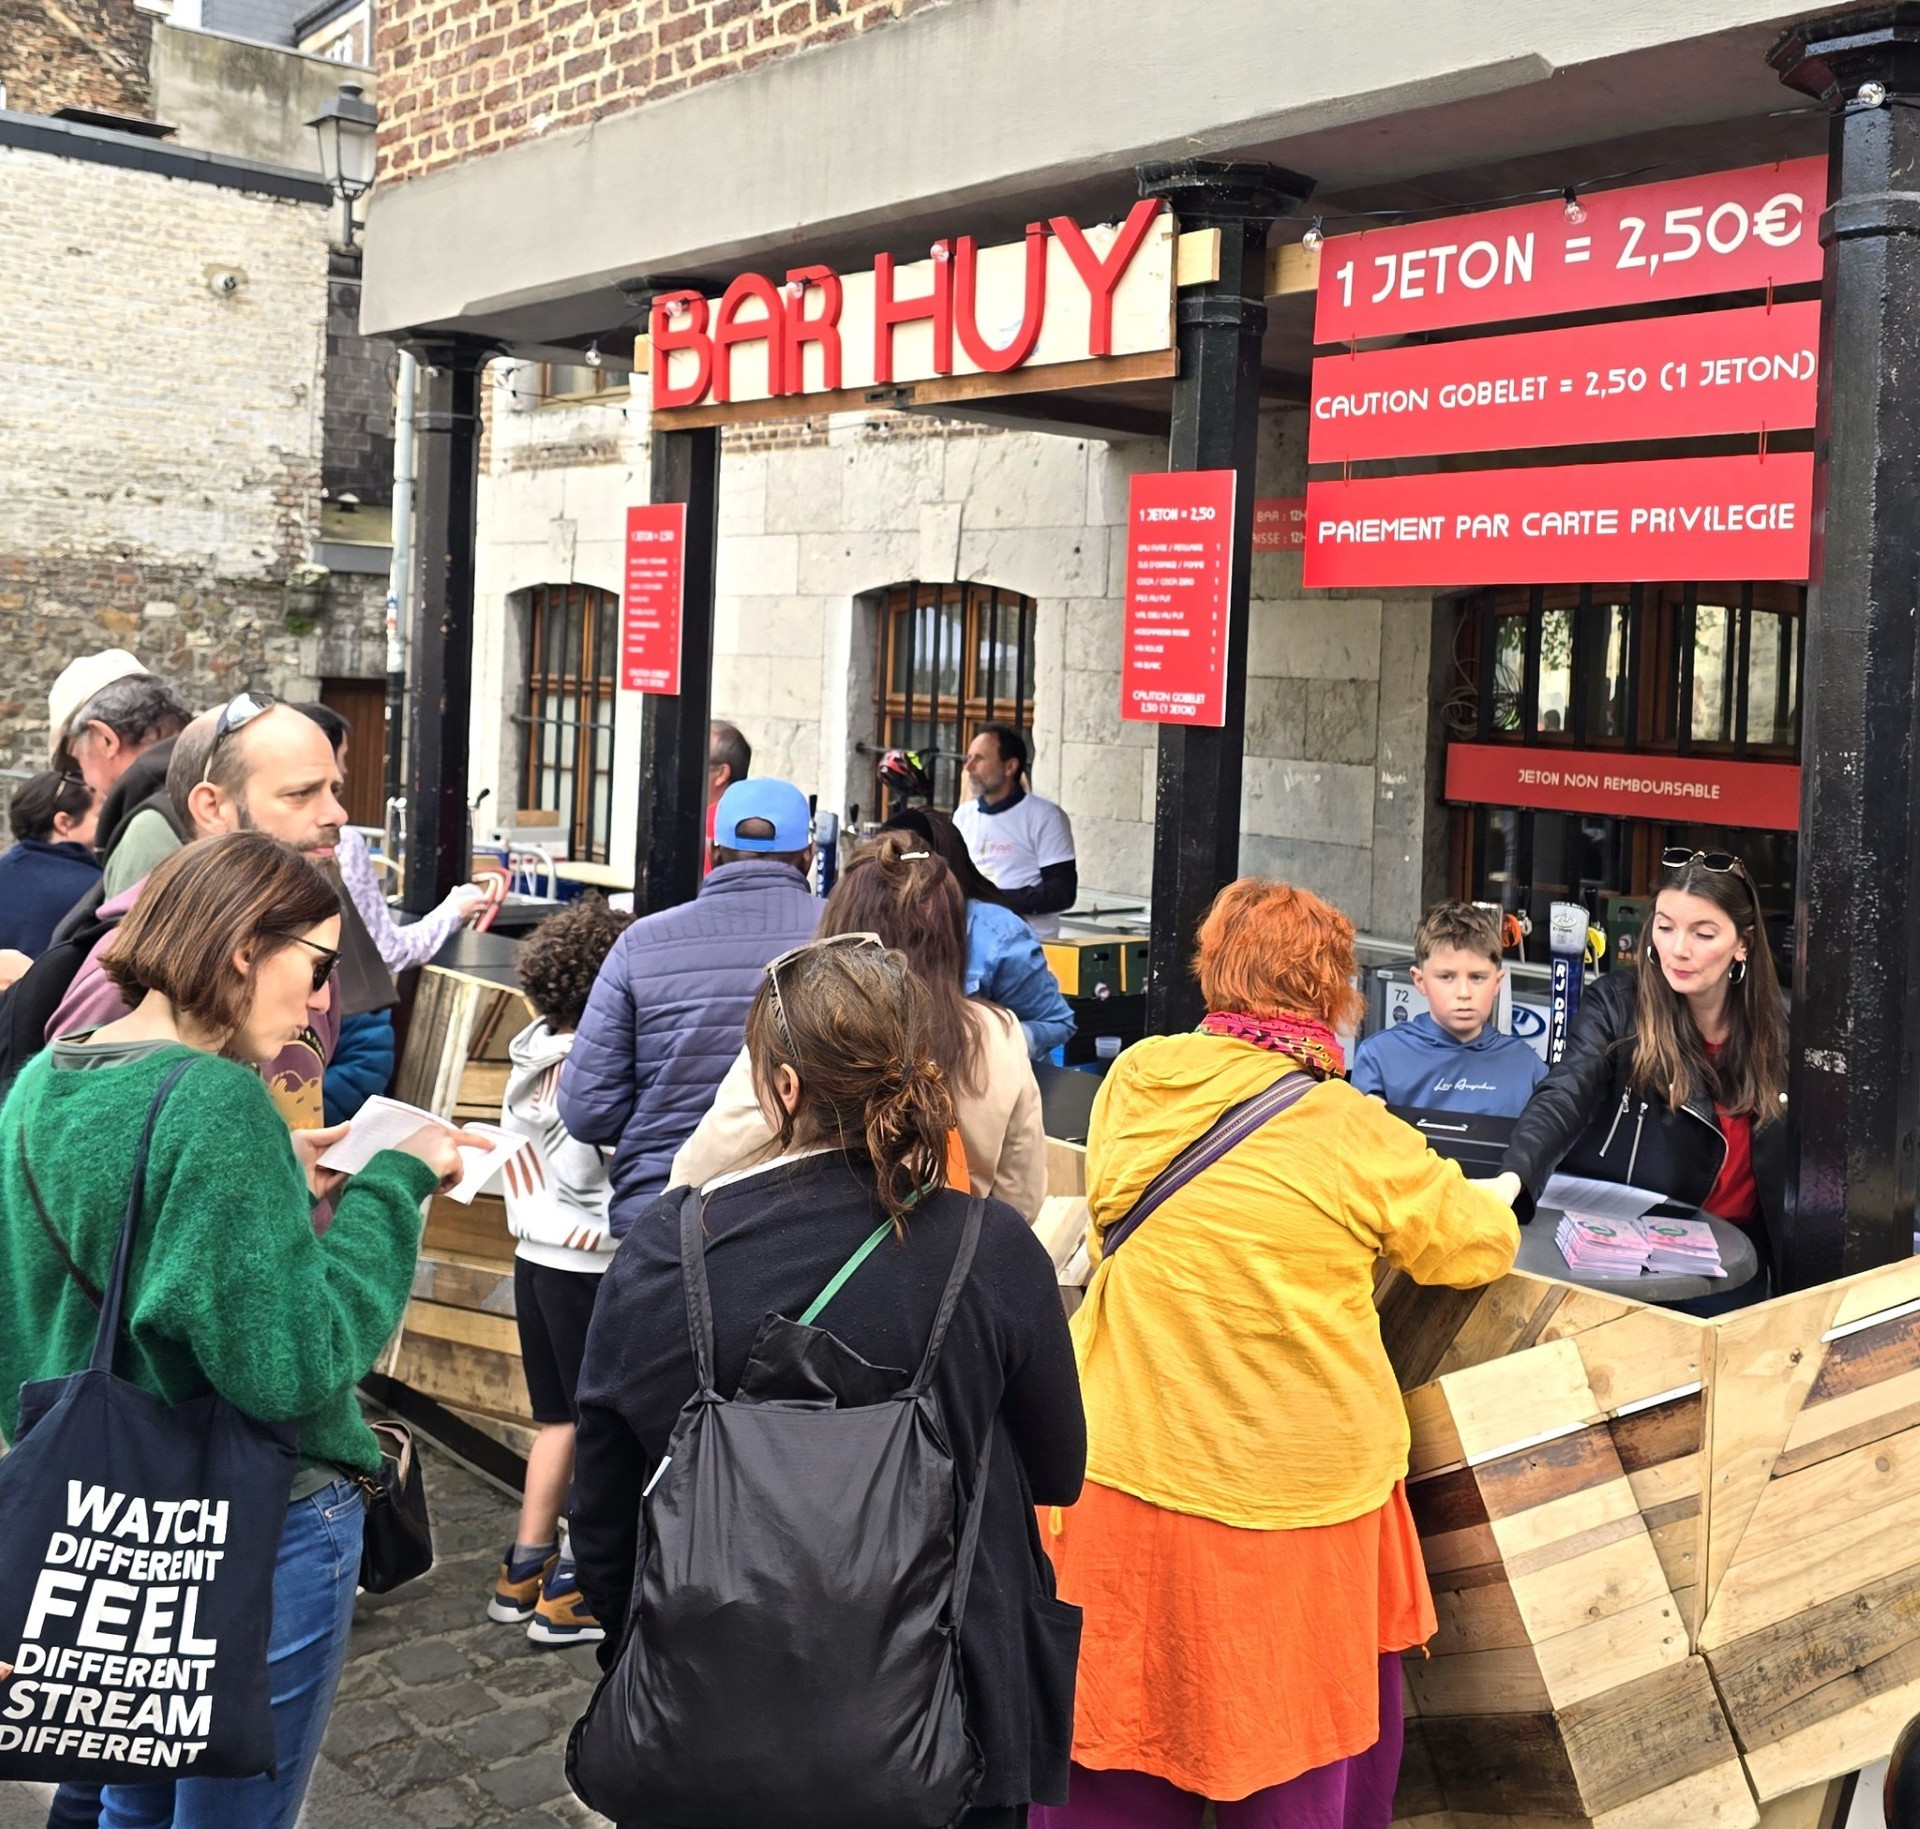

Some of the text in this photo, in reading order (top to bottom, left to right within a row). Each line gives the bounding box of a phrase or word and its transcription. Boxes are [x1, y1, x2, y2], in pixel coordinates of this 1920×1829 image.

[1337, 194, 1803, 307] 1 JETON = 2,50€
[652, 198, 1164, 409] BAR HUY
[1315, 350, 1816, 419] CAUTION GOBELET = 2,50 (1 JETON)
[1139, 508, 1145, 521] 1
[1147, 508, 1178, 521] JETON
[1252, 532, 1280, 544] AISSE
[1257, 511, 1279, 522] BAR
[1318, 504, 1795, 544] PAIEMENT PAR CARTE PRIVILEGIE
[1518, 769, 1720, 799] JETON NON REMBOURSABLE
[1394, 988, 1410, 1004] 72
[67, 1480, 230, 1545] WATCH
[45, 1532, 224, 1581] DIFFERENT
[22, 1569, 218, 1656] FEEL
[13, 1643, 216, 1691] DIFFERENT
[2, 1680, 213, 1736] STREAM
[0, 1725, 208, 1768] DIFFERENT
